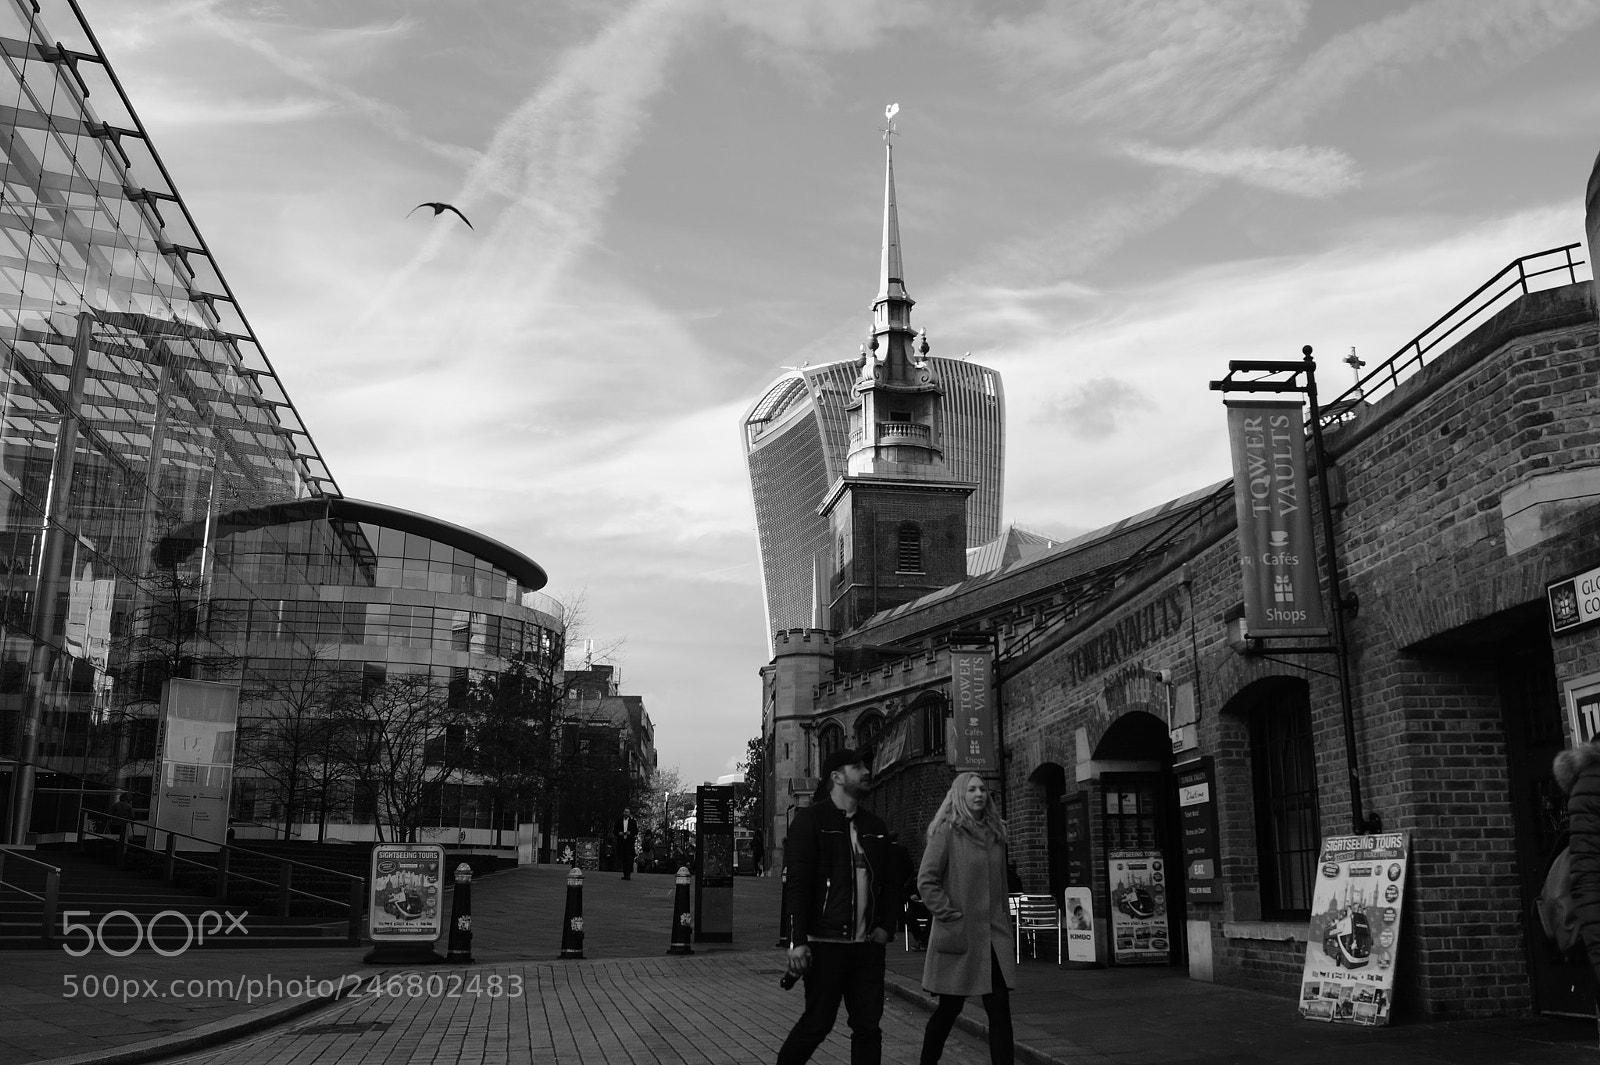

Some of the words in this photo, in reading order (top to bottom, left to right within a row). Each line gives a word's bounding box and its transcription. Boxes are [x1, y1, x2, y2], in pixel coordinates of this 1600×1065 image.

[1269, 415, 1298, 517] VAULTS
[1262, 552, 1299, 566] Cafés
[1116, 590, 1182, 657] VAULTS
[1266, 608, 1307, 624] Shops
[959, 657, 972, 711] TOWER
[972, 656, 985, 711] VAULTS
[1376, 835, 1402, 849] TOURS
[379, 851, 417, 859] SIGHTSEEING
[418, 851, 438, 859] TOURS
[1069, 933, 1092, 941] KIMBO
